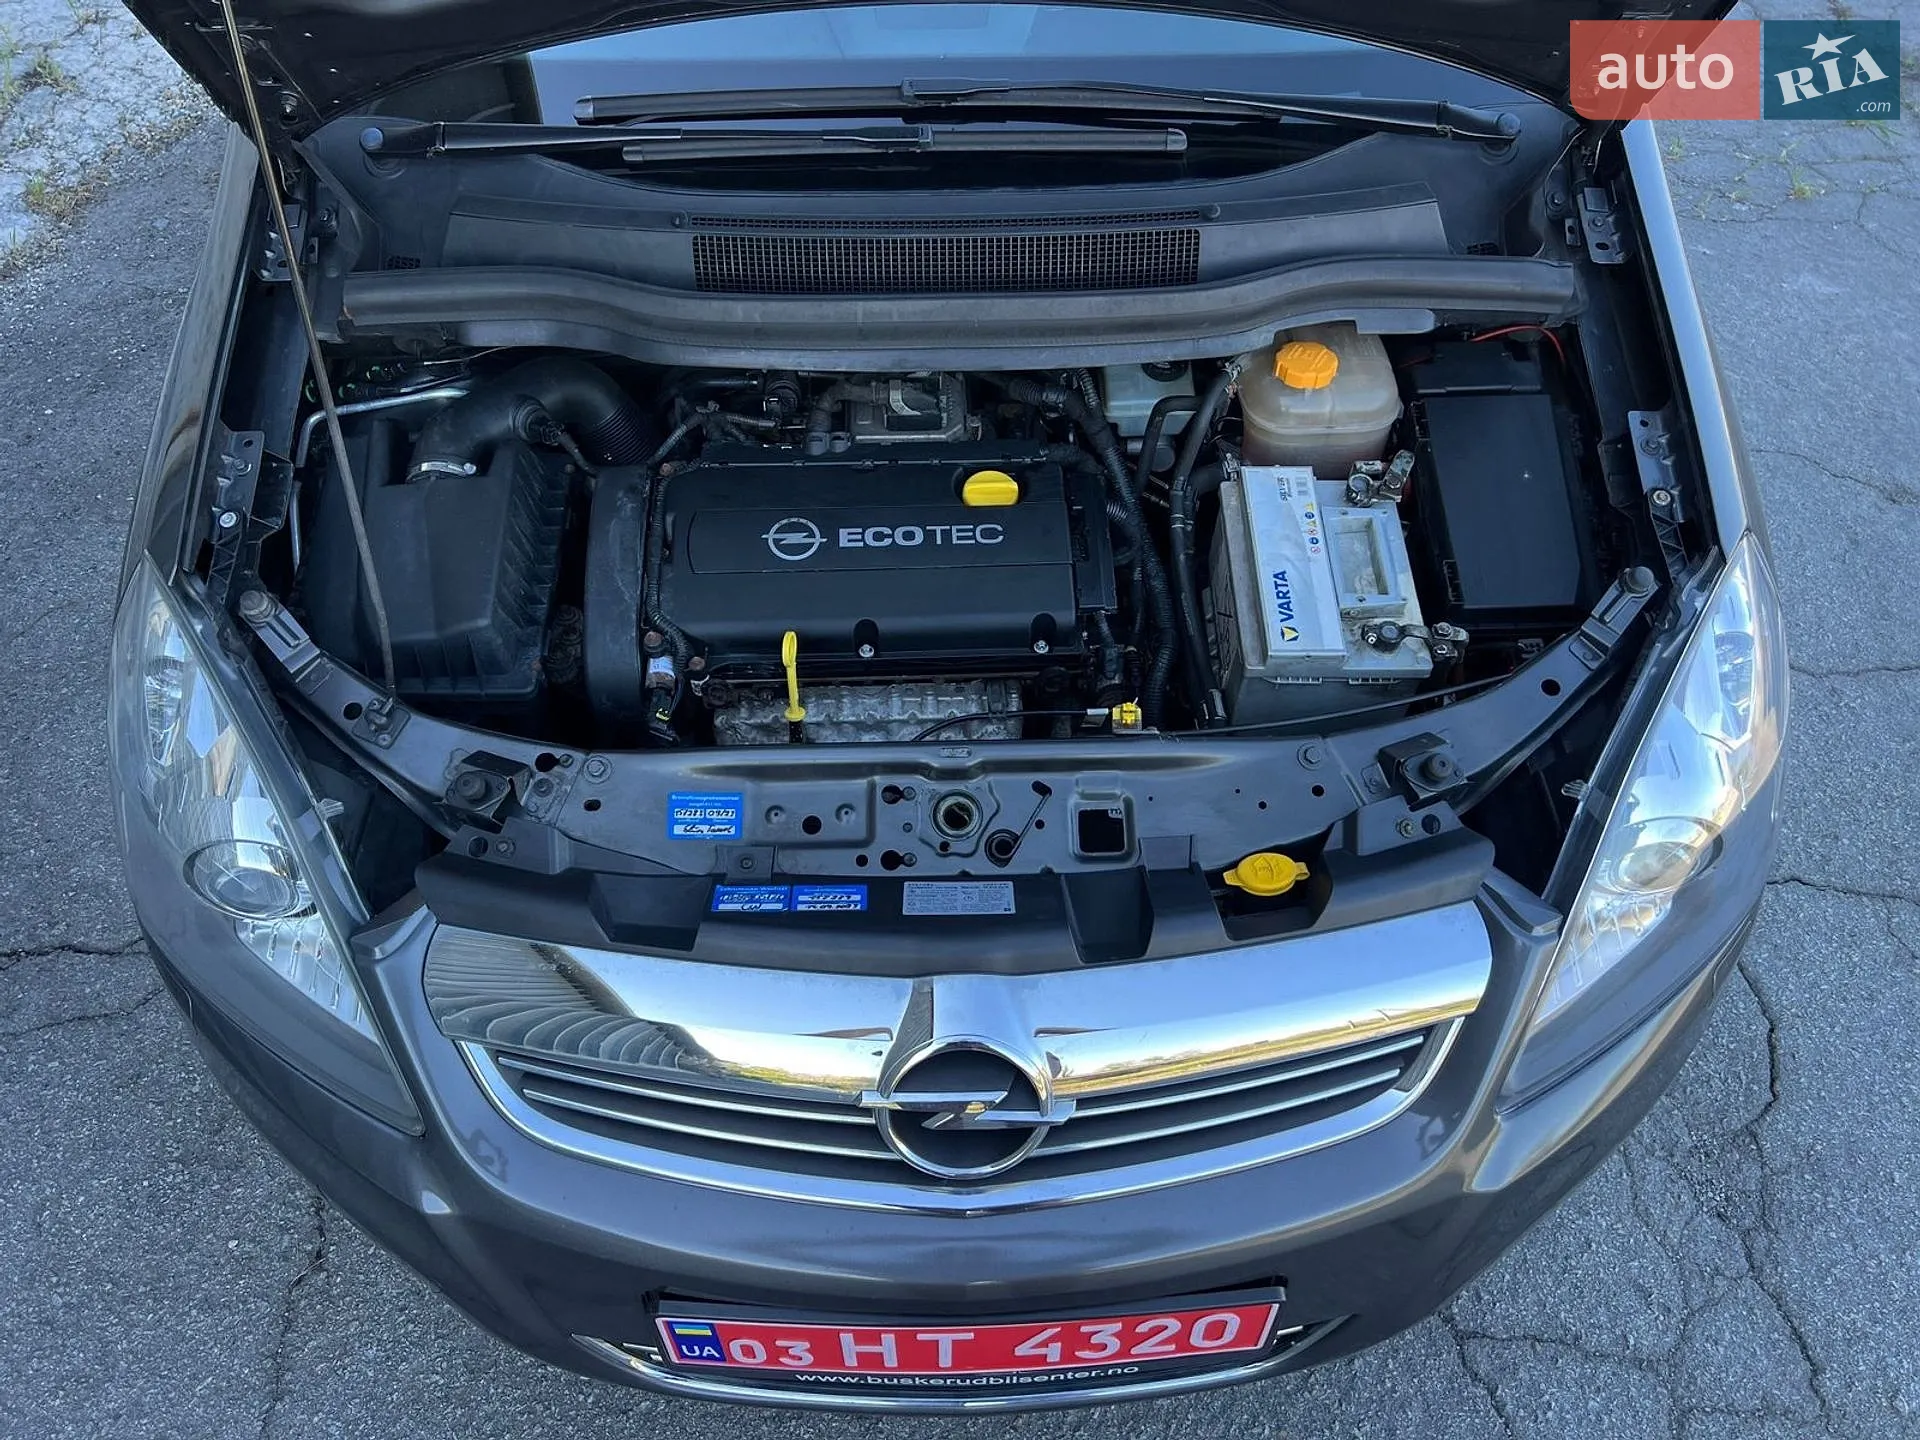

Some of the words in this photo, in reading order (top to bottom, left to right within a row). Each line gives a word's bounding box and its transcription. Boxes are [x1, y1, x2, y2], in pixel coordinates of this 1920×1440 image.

[838, 523, 1005, 548] ECOTEC
[1273, 570, 1295, 623] VARTA
[681, 1344, 721, 1359] UA
[728, 1338, 814, 1367] 03
[838, 1331, 975, 1369] HT
[1014, 1313, 1242, 1364] 4320
[795, 1365, 1139, 1386] www.buskerudbilsenter.no
